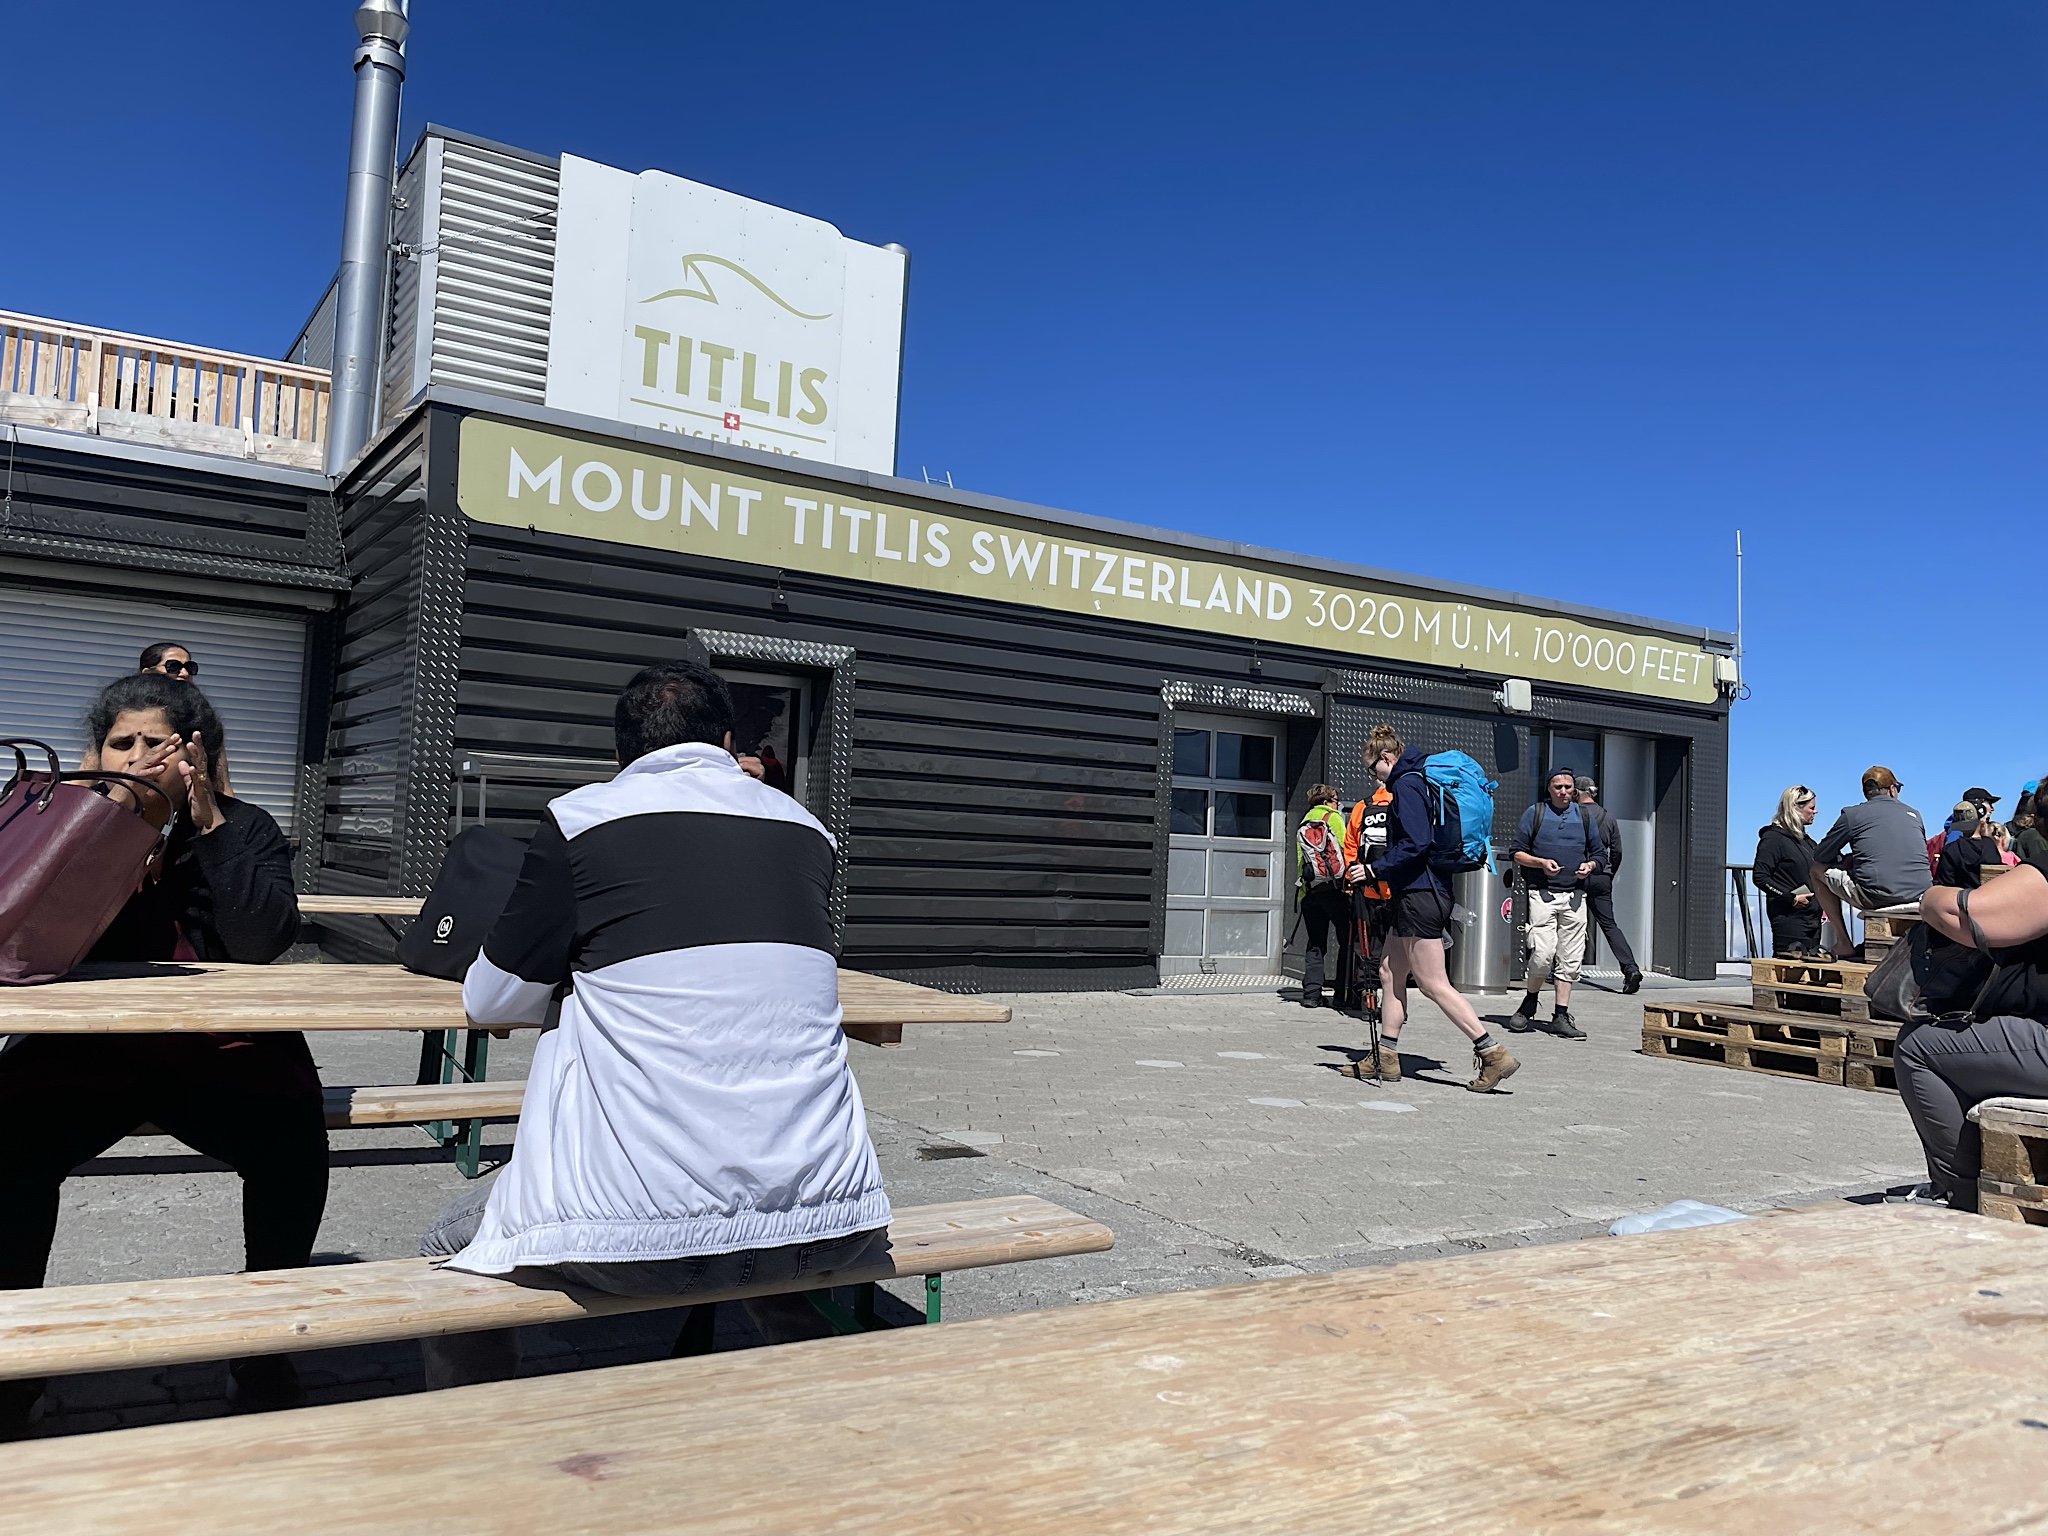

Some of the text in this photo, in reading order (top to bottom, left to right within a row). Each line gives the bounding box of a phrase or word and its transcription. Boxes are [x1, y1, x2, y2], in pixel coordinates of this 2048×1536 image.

[634, 323, 828, 425] TITLIS
[508, 446, 762, 536] MOUNT
[784, 495, 951, 568] TITLIS
[968, 530, 1292, 621] SWITZERLAND
[1305, 588, 1404, 639] 3020
[1414, 606, 1440, 645] M
[1641, 645, 1706, 686] FEET
